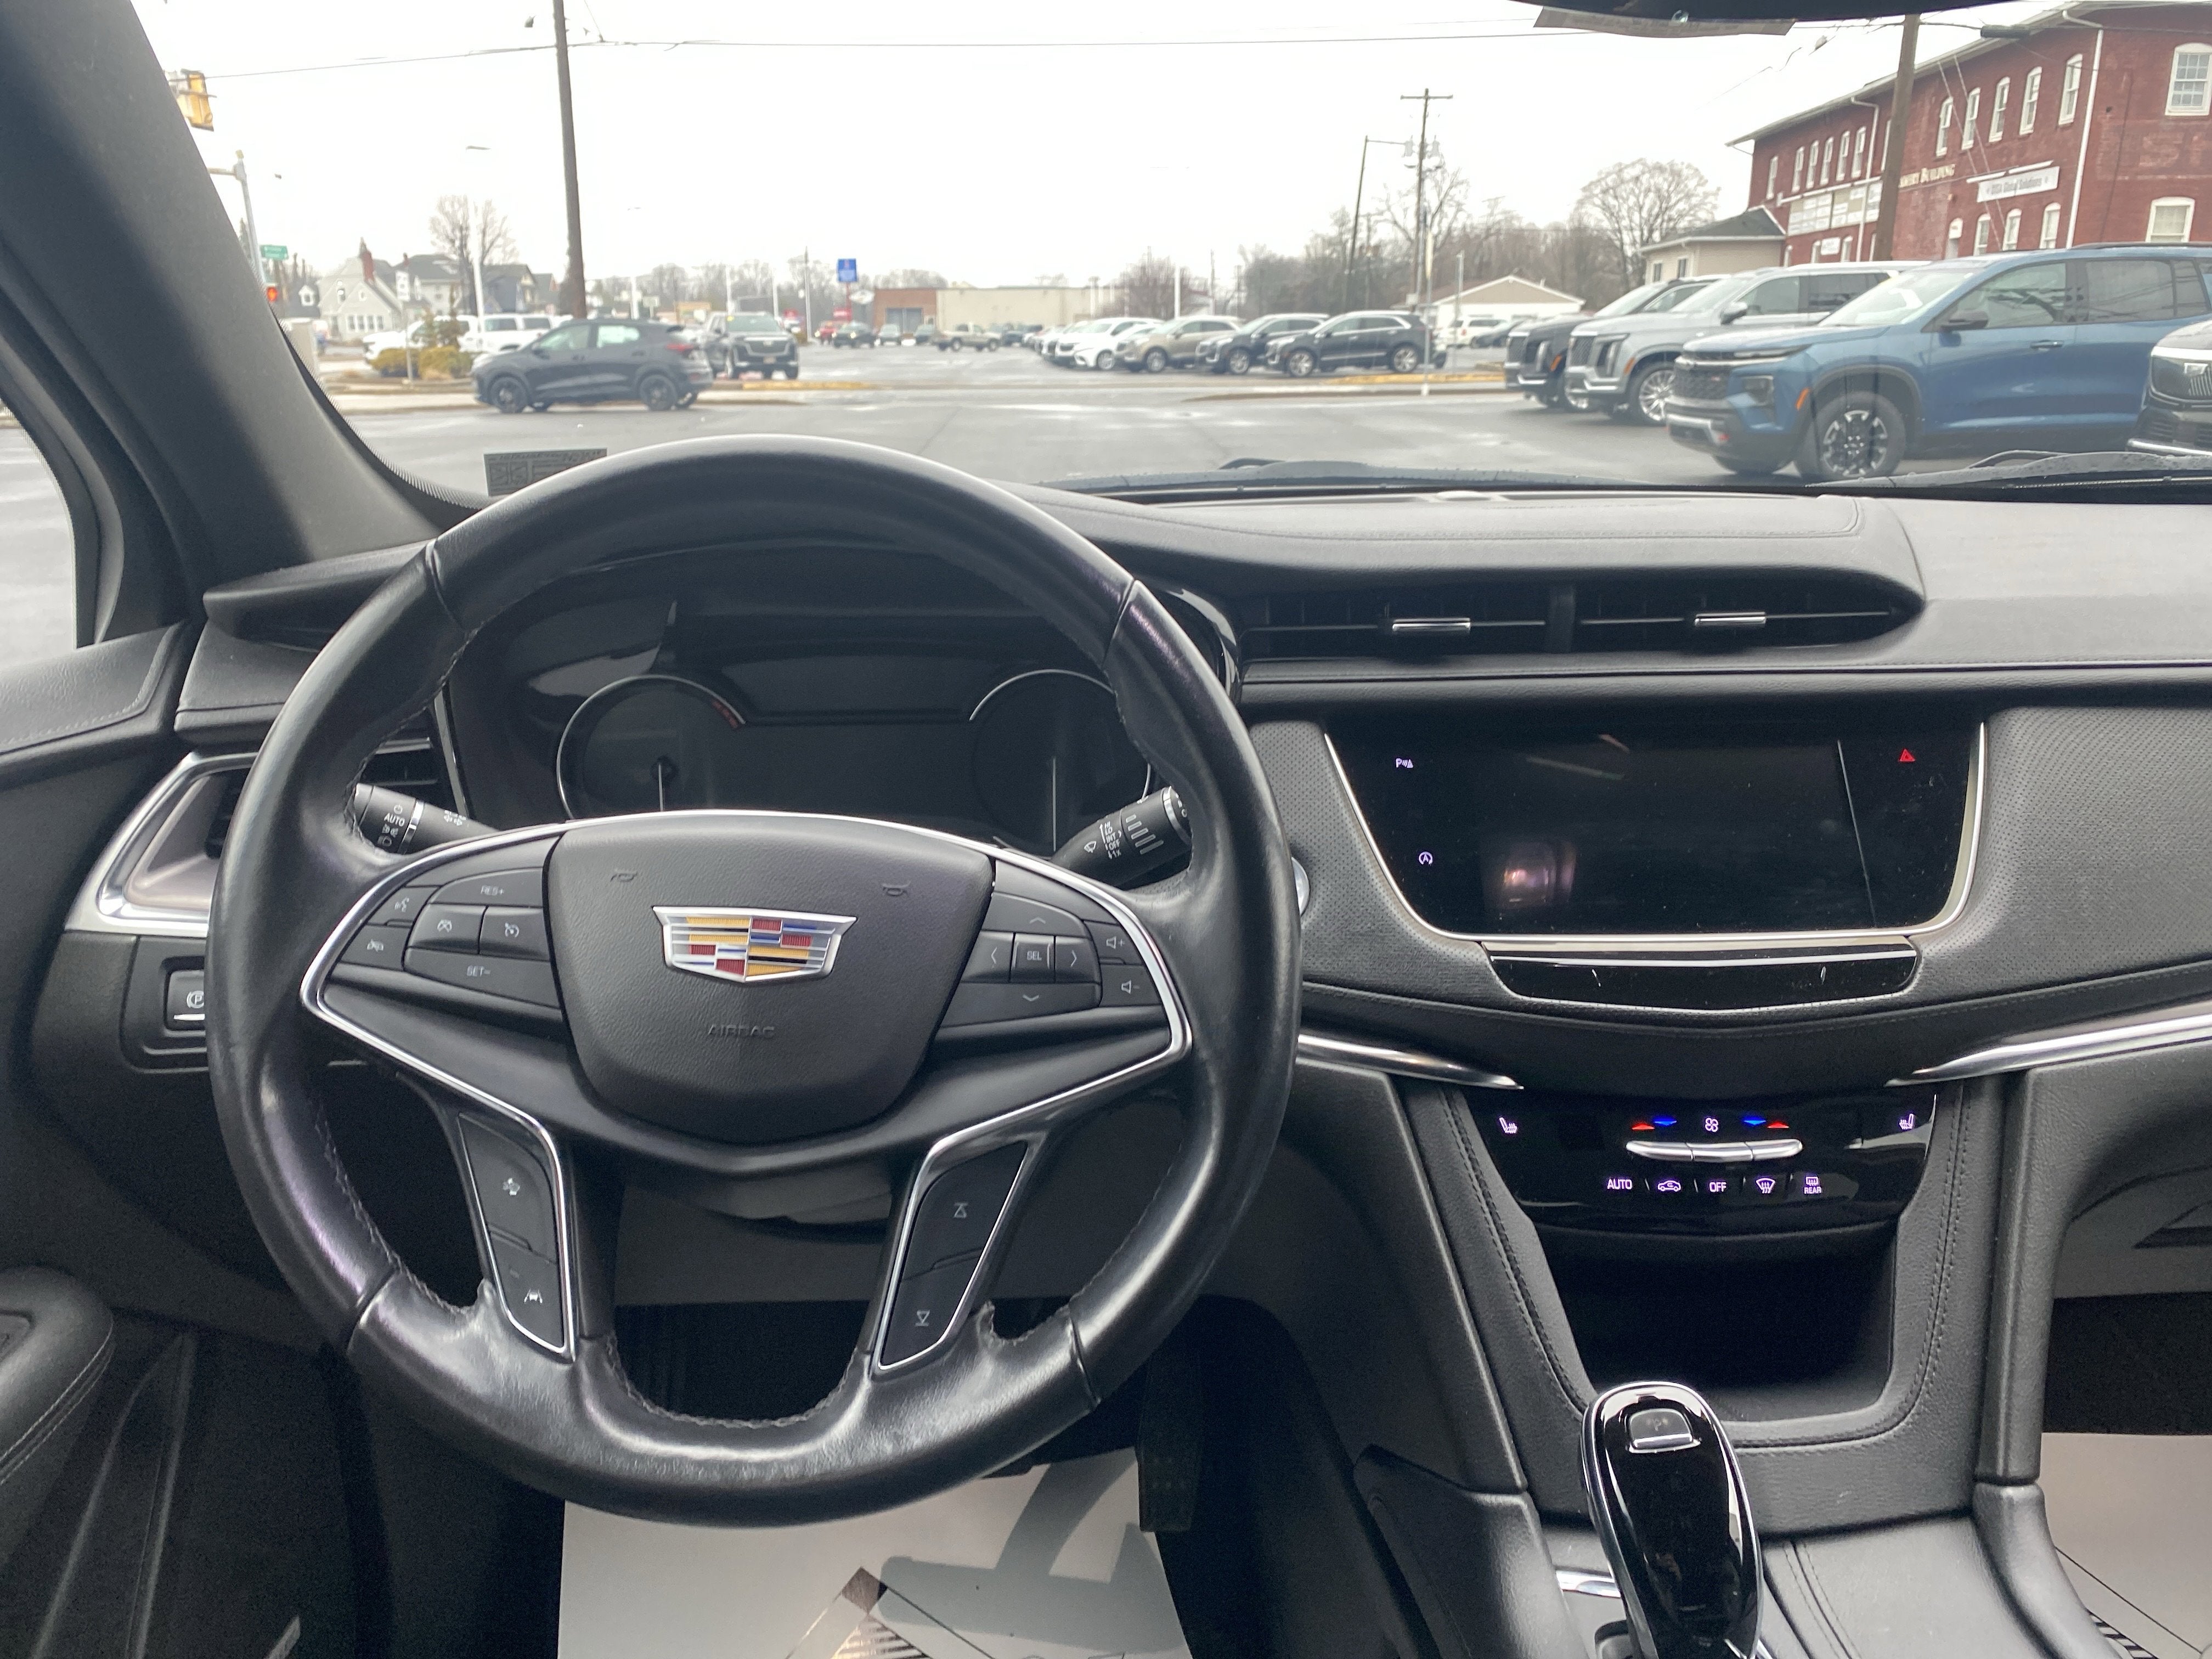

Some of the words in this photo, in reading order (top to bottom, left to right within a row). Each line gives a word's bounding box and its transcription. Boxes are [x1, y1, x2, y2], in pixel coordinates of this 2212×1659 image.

[384, 812, 405, 827] AUTO
[1105, 826, 1113, 836] LO
[1106, 832, 1116, 844] INT
[1108, 839, 1120, 850] OFF
[1026, 950, 1042, 961] SEL
[1606, 1178, 1633, 1190] AUTO
[1709, 1182, 1727, 1193] OFF
[1803, 1186, 1822, 1194] REAR
